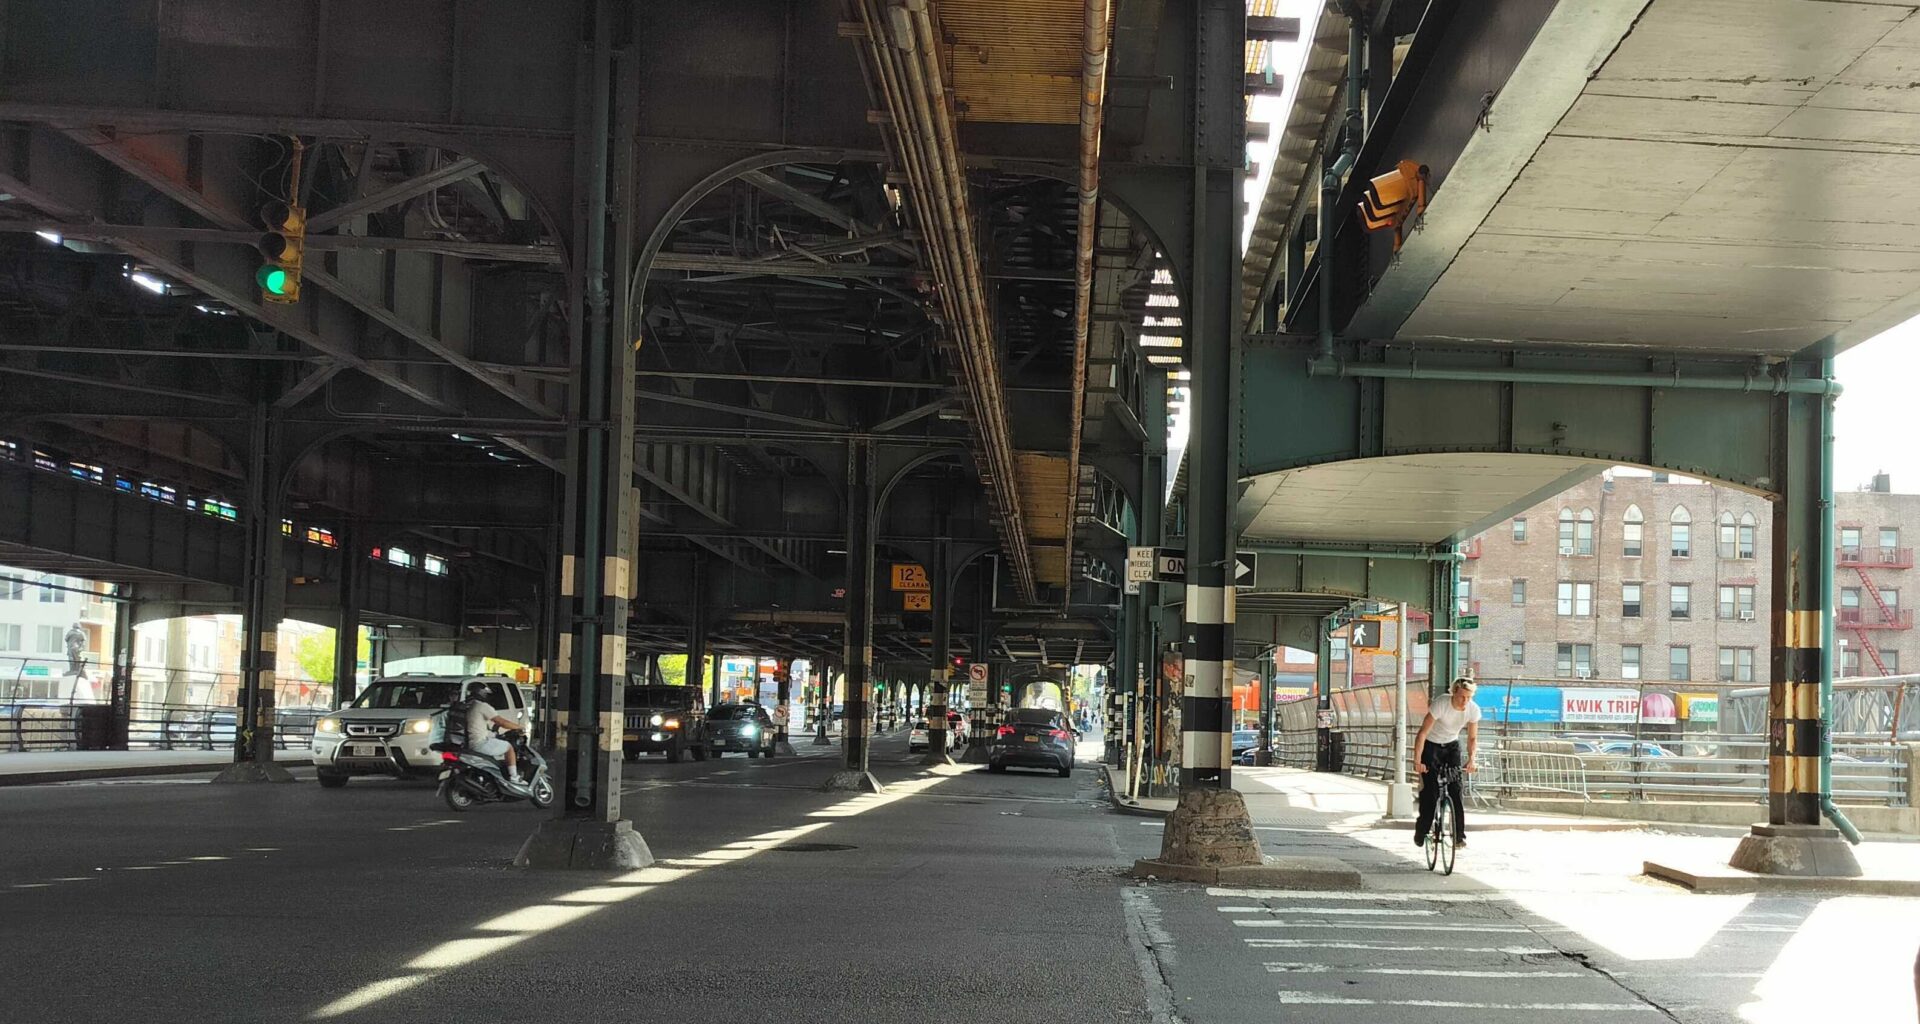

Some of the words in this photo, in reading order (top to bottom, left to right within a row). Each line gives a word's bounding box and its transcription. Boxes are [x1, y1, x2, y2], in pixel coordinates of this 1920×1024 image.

[1130, 560, 1152, 568] INTERSEC
[1167, 559, 1185, 572] ON
[900, 567, 922, 581] 12'-
[1134, 570, 1152, 578] CLEA
[1128, 584, 1139, 592] ON
[1566, 699, 1603, 713] KWIK
[1607, 700, 1639, 714] TRIP
